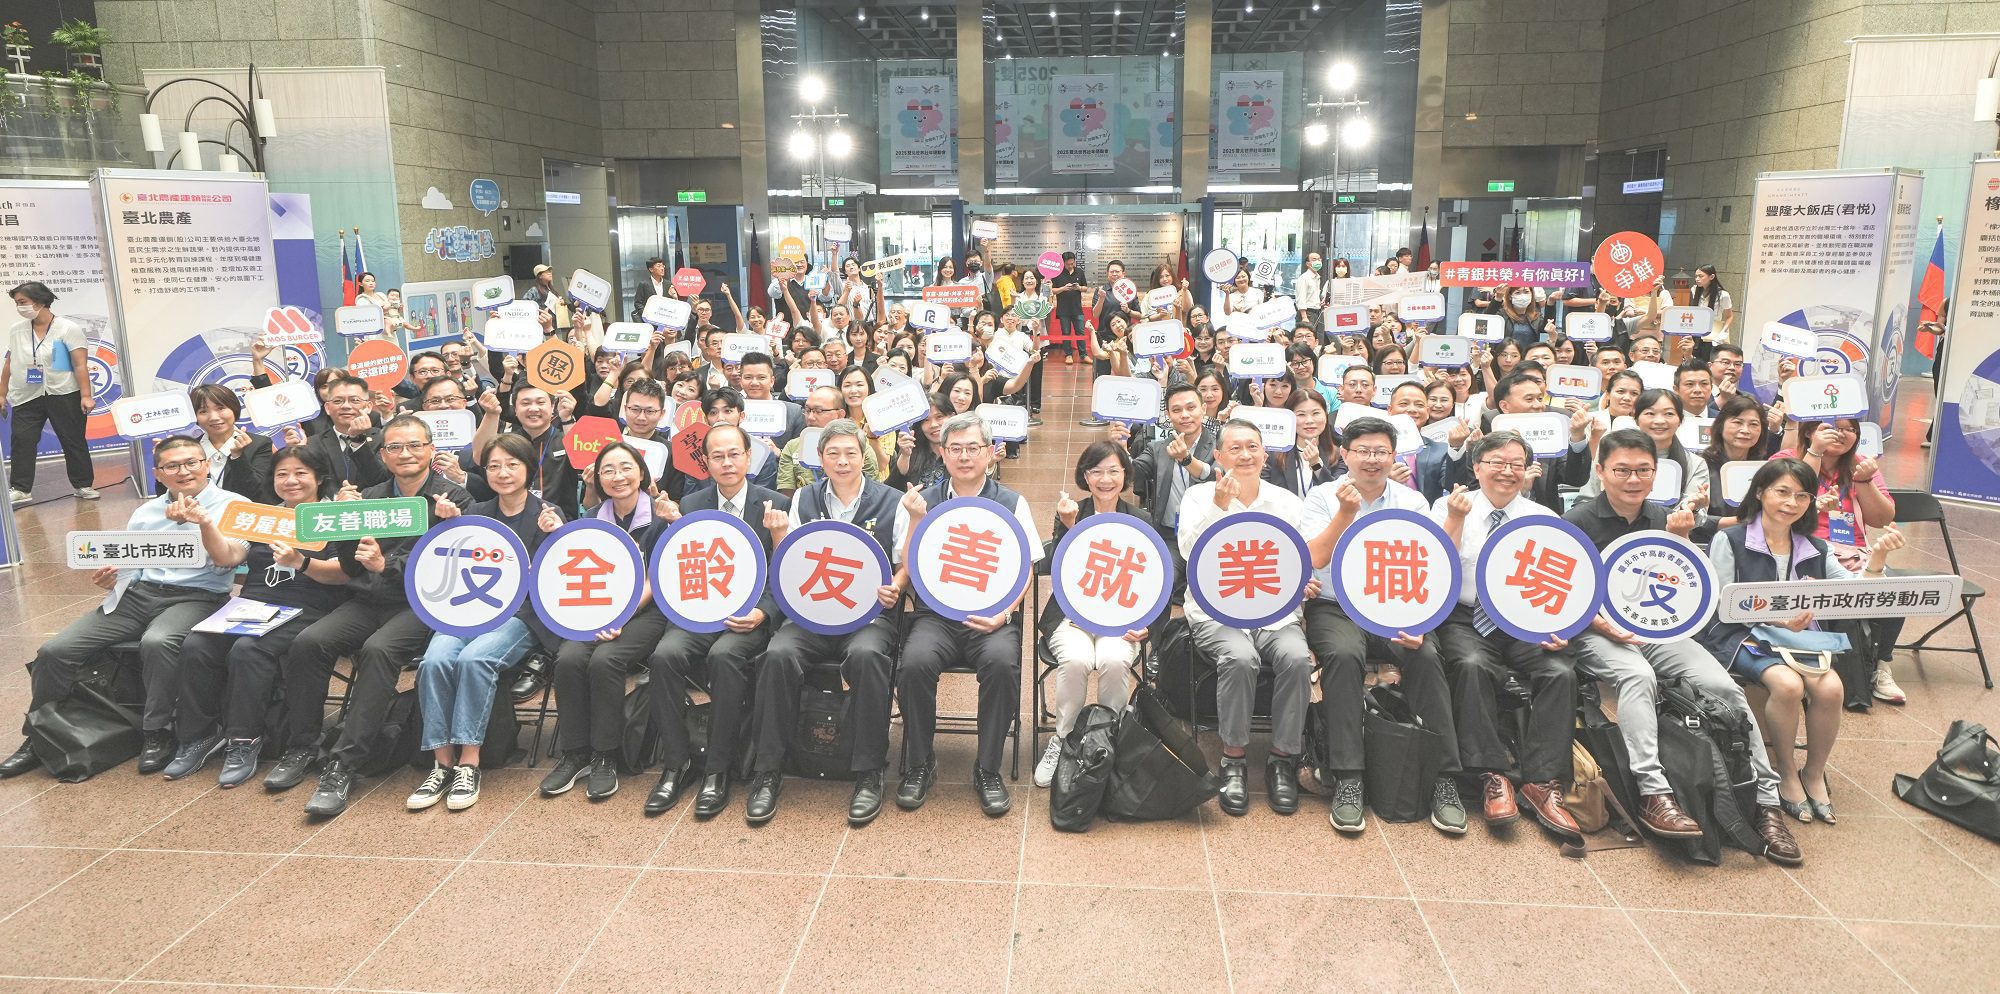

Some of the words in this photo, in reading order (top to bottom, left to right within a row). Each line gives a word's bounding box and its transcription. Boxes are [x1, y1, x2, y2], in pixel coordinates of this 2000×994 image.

[122, 210, 192, 225] 臺北農產
[267, 335, 287, 343] MOS
[287, 333, 319, 342] BURGER
[1149, 335, 1166, 344] CDS
[542, 354, 568, 381] 聚
[231, 511, 296, 539] 勞雇雙
[312, 508, 413, 533] 友善職場
[102, 542, 195, 560] 臺北市政府
[938, 523, 1003, 593] 善
[557, 548, 616, 608] 全
[676, 536, 737, 602] 齡
[798, 545, 864, 610] 友
[1077, 538, 1146, 609] 就
[1216, 539, 1282, 599] 業
[1363, 539, 1430, 604] 職
[1504, 539, 1575, 616] 場
[1768, 590, 1941, 612] 臺北市政府勞動局
[1622, 605, 1680, 627] 友善企業認證
